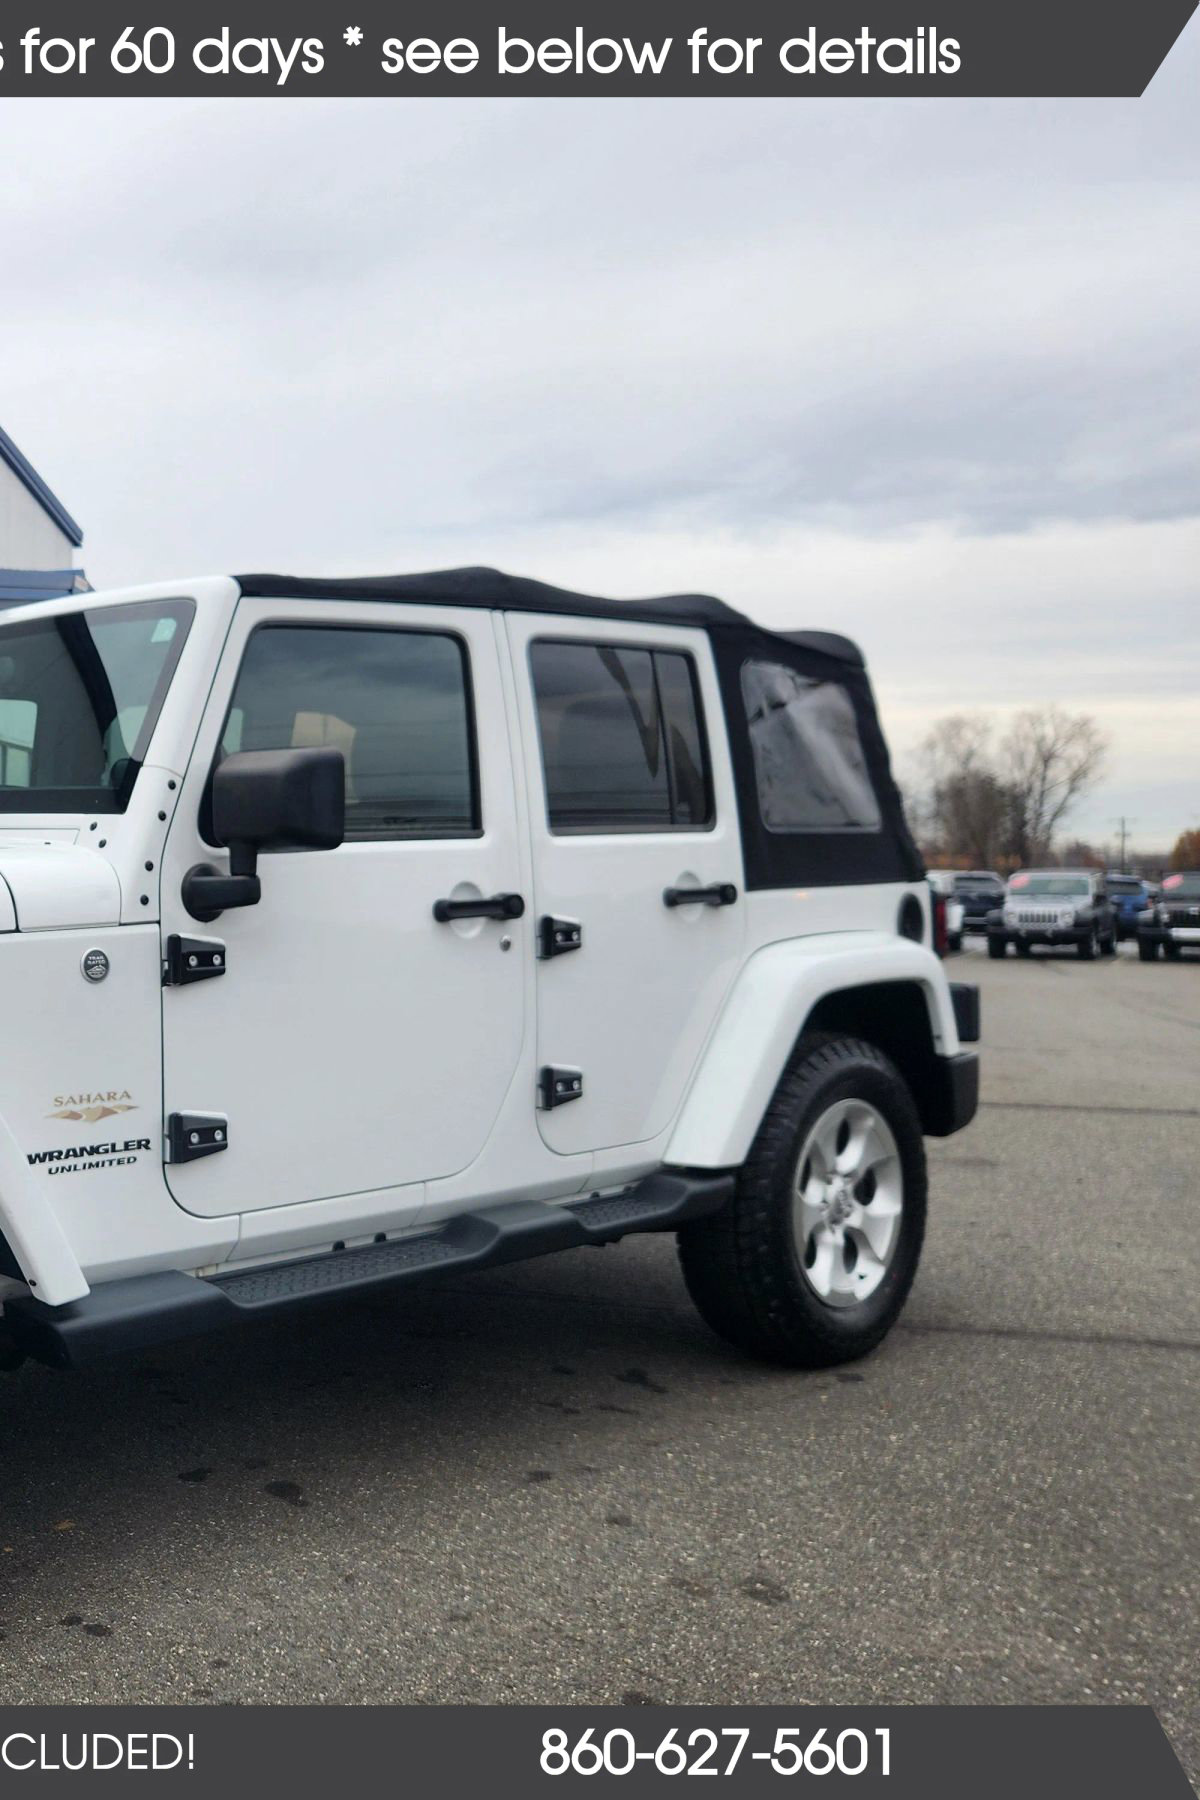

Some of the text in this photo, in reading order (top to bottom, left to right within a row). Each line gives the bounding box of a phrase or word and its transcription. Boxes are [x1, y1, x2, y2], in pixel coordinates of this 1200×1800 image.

[54, 1090, 132, 1107] SAHARA
[27, 1138, 151, 1165] WRANGLER
[48, 1156, 137, 1175] UNLIMITED
